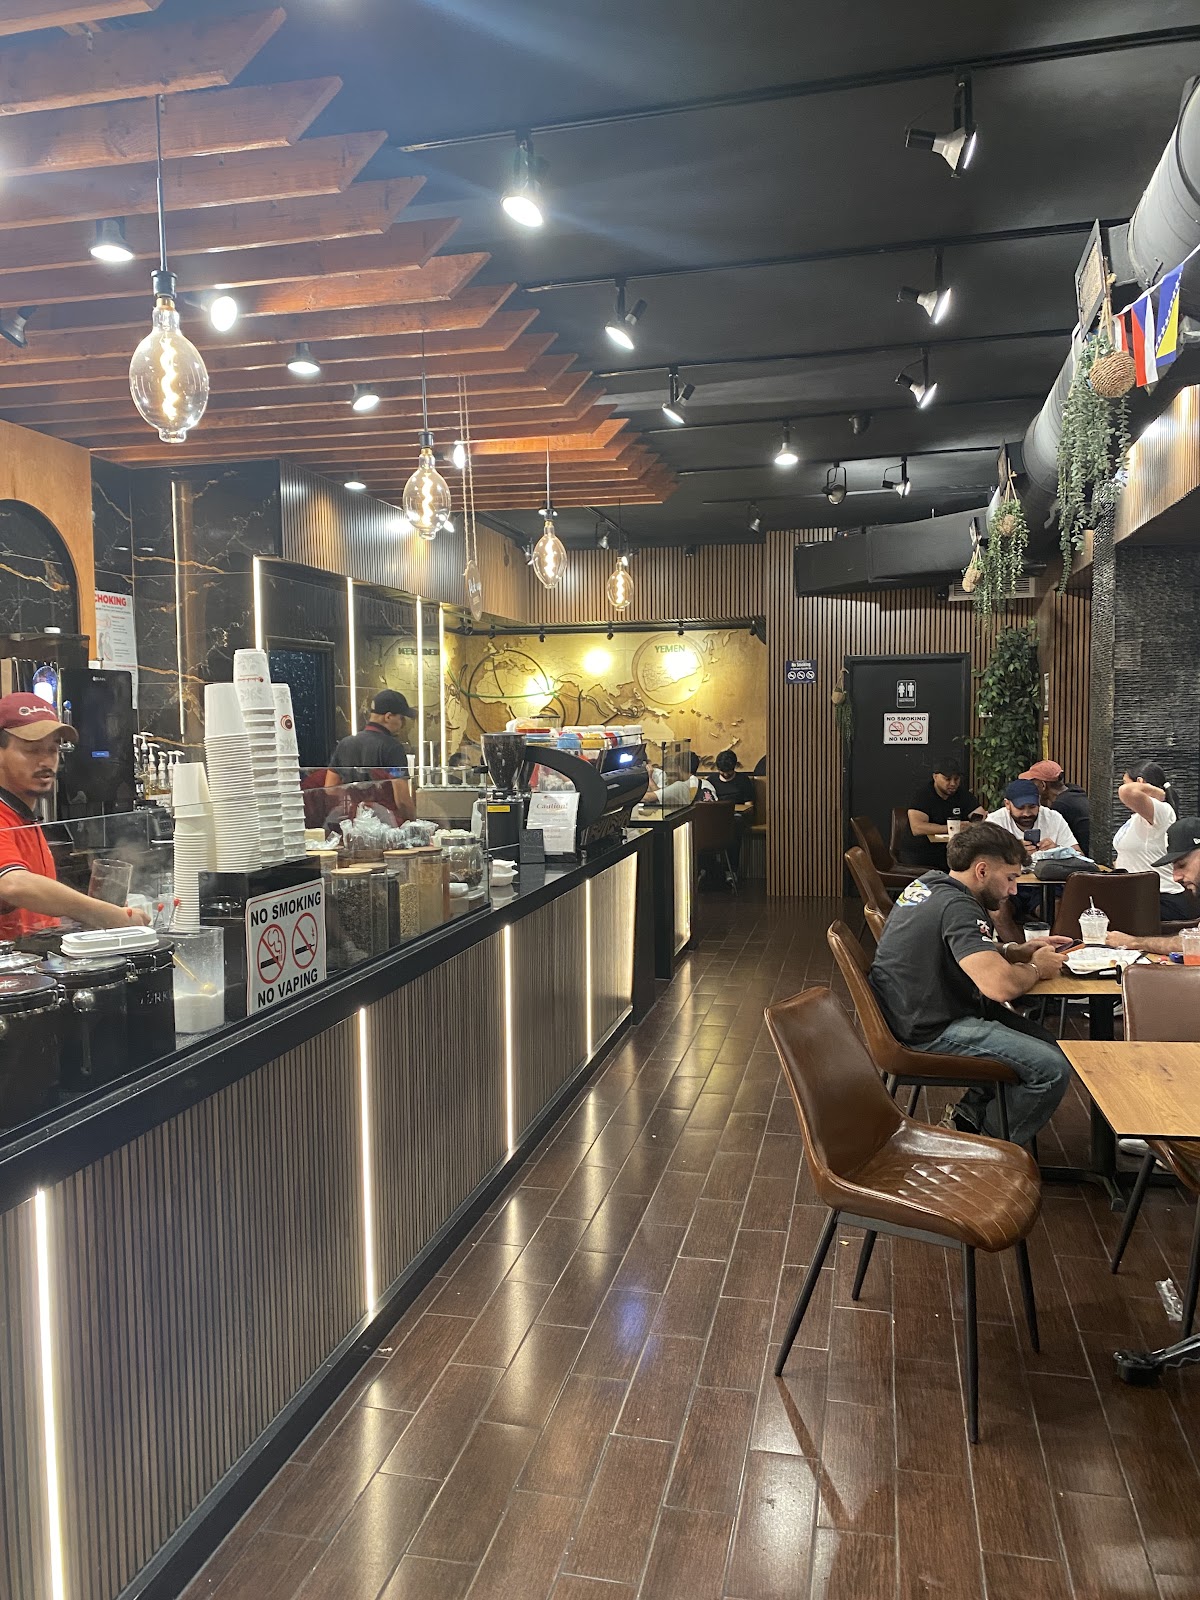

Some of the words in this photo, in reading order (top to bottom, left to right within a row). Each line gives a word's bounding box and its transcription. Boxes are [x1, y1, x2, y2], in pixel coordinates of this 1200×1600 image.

[654, 644, 686, 653] YEMEN
[250, 908, 268, 927] NO
[272, 891, 322, 920] SMOKING
[257, 987, 275, 1008] NO
[278, 968, 318, 998] VAPING
